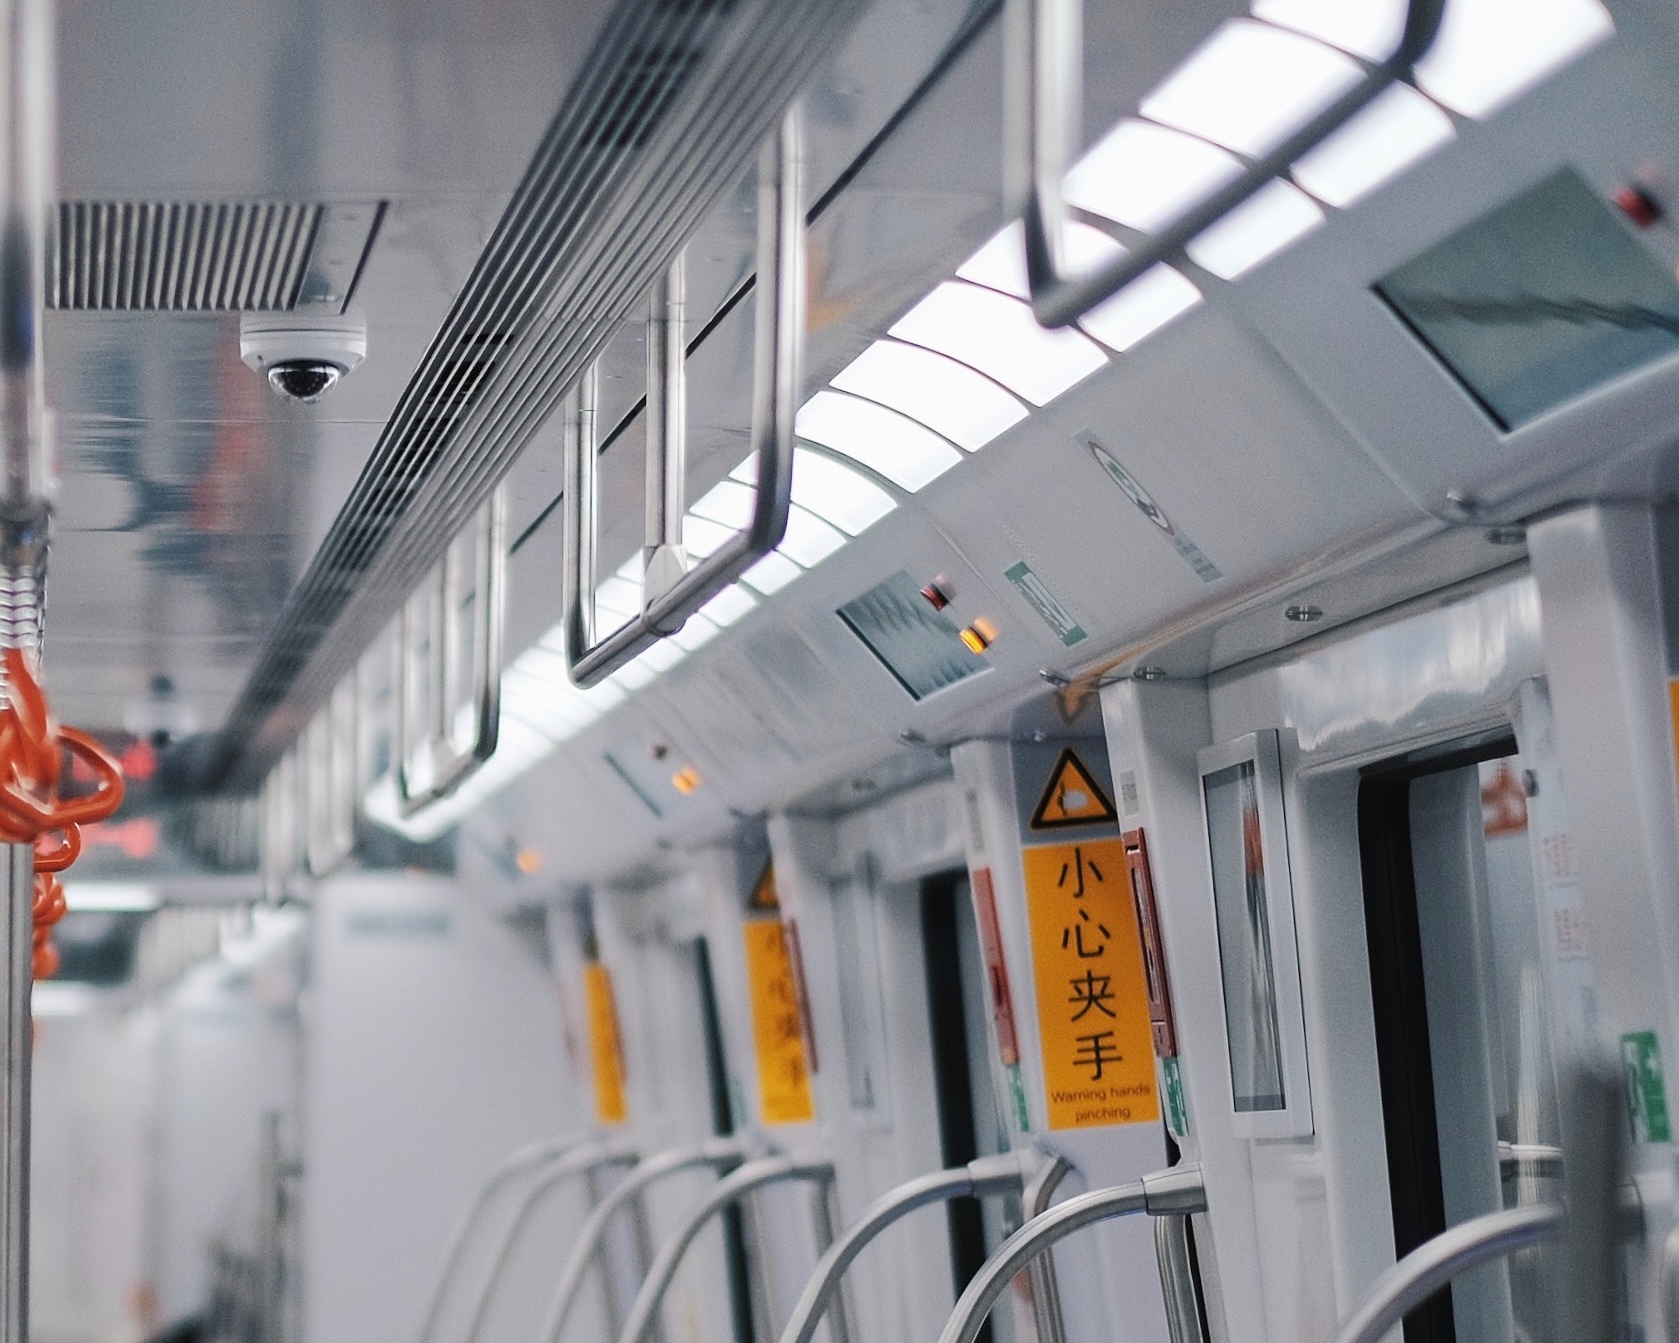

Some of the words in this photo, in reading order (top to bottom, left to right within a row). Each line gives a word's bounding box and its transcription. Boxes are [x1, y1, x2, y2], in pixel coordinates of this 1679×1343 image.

[1057, 847, 1123, 1081] 小心夹手
[1050, 1089, 1106, 1103] Warning
[1110, 1084, 1151, 1098] hands
[1076, 1107, 1131, 1123] pinching
